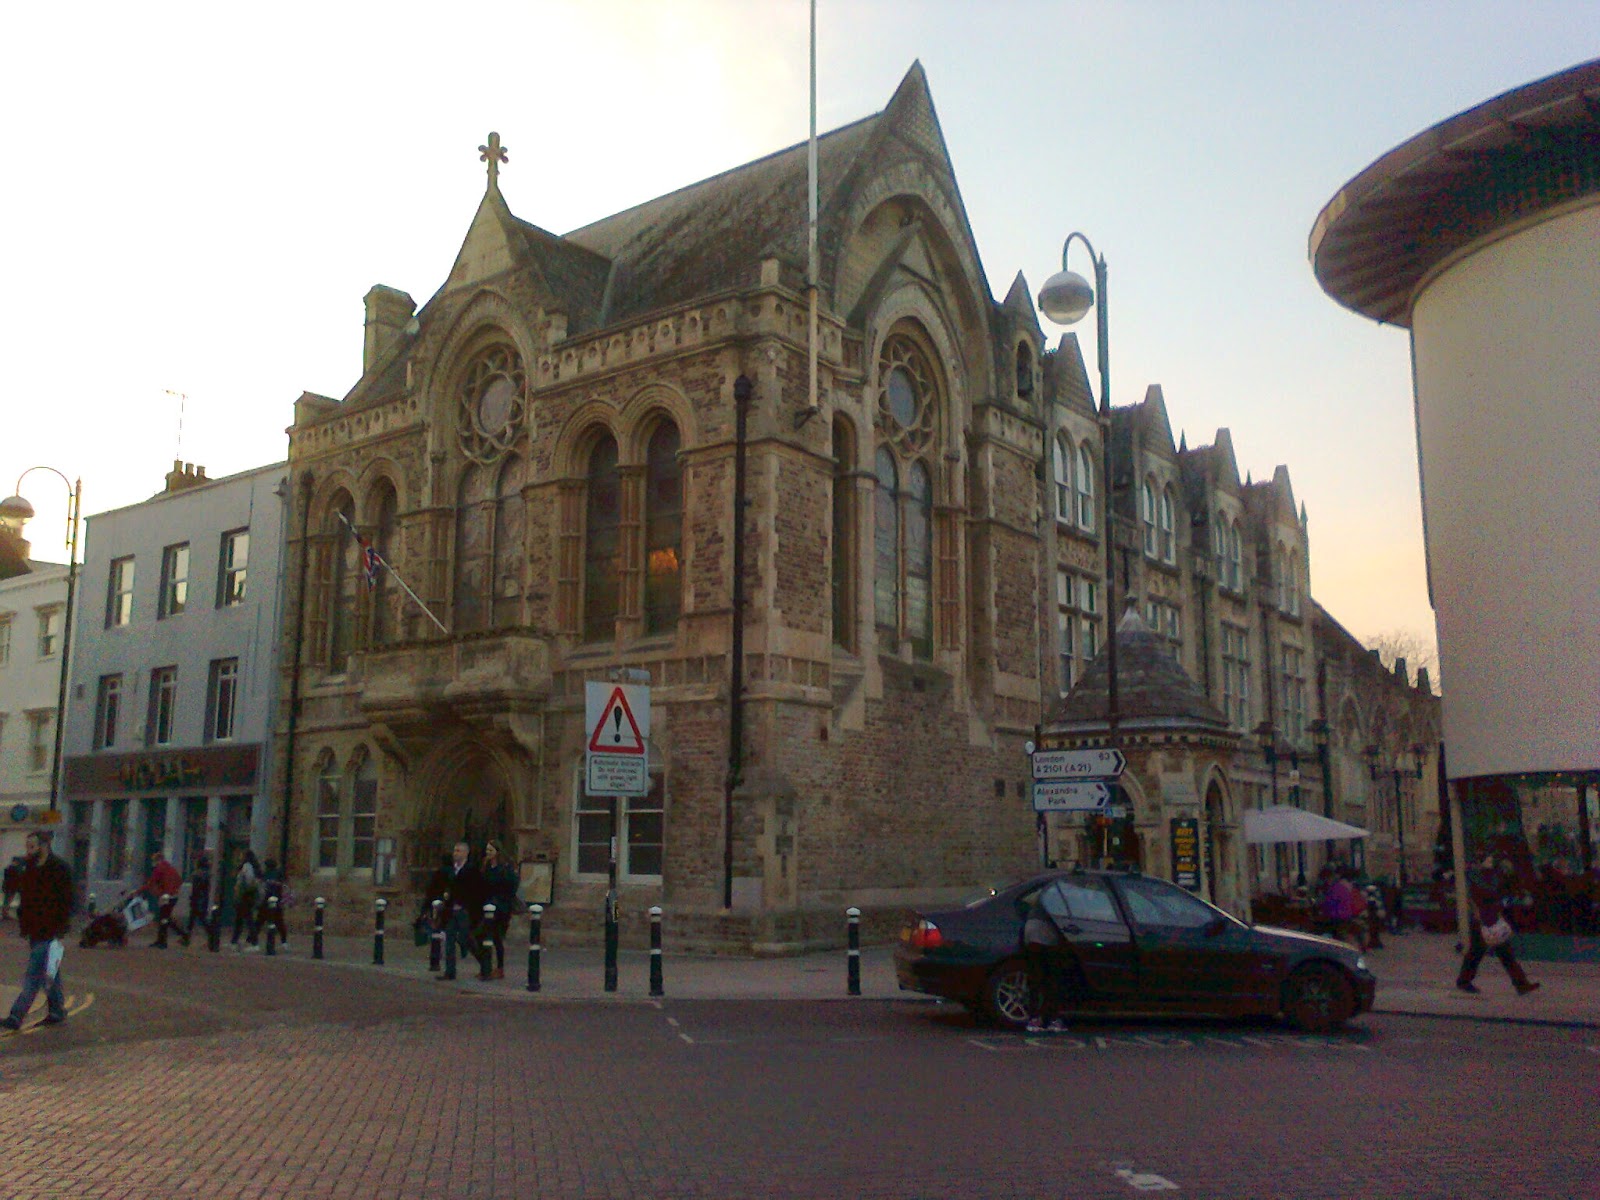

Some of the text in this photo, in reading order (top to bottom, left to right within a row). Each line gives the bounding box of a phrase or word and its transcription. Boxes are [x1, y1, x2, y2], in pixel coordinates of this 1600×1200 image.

[1034, 755, 1065, 764] London
[1036, 787, 1078, 795] Alexandra
[1047, 796, 1067, 805] Park
